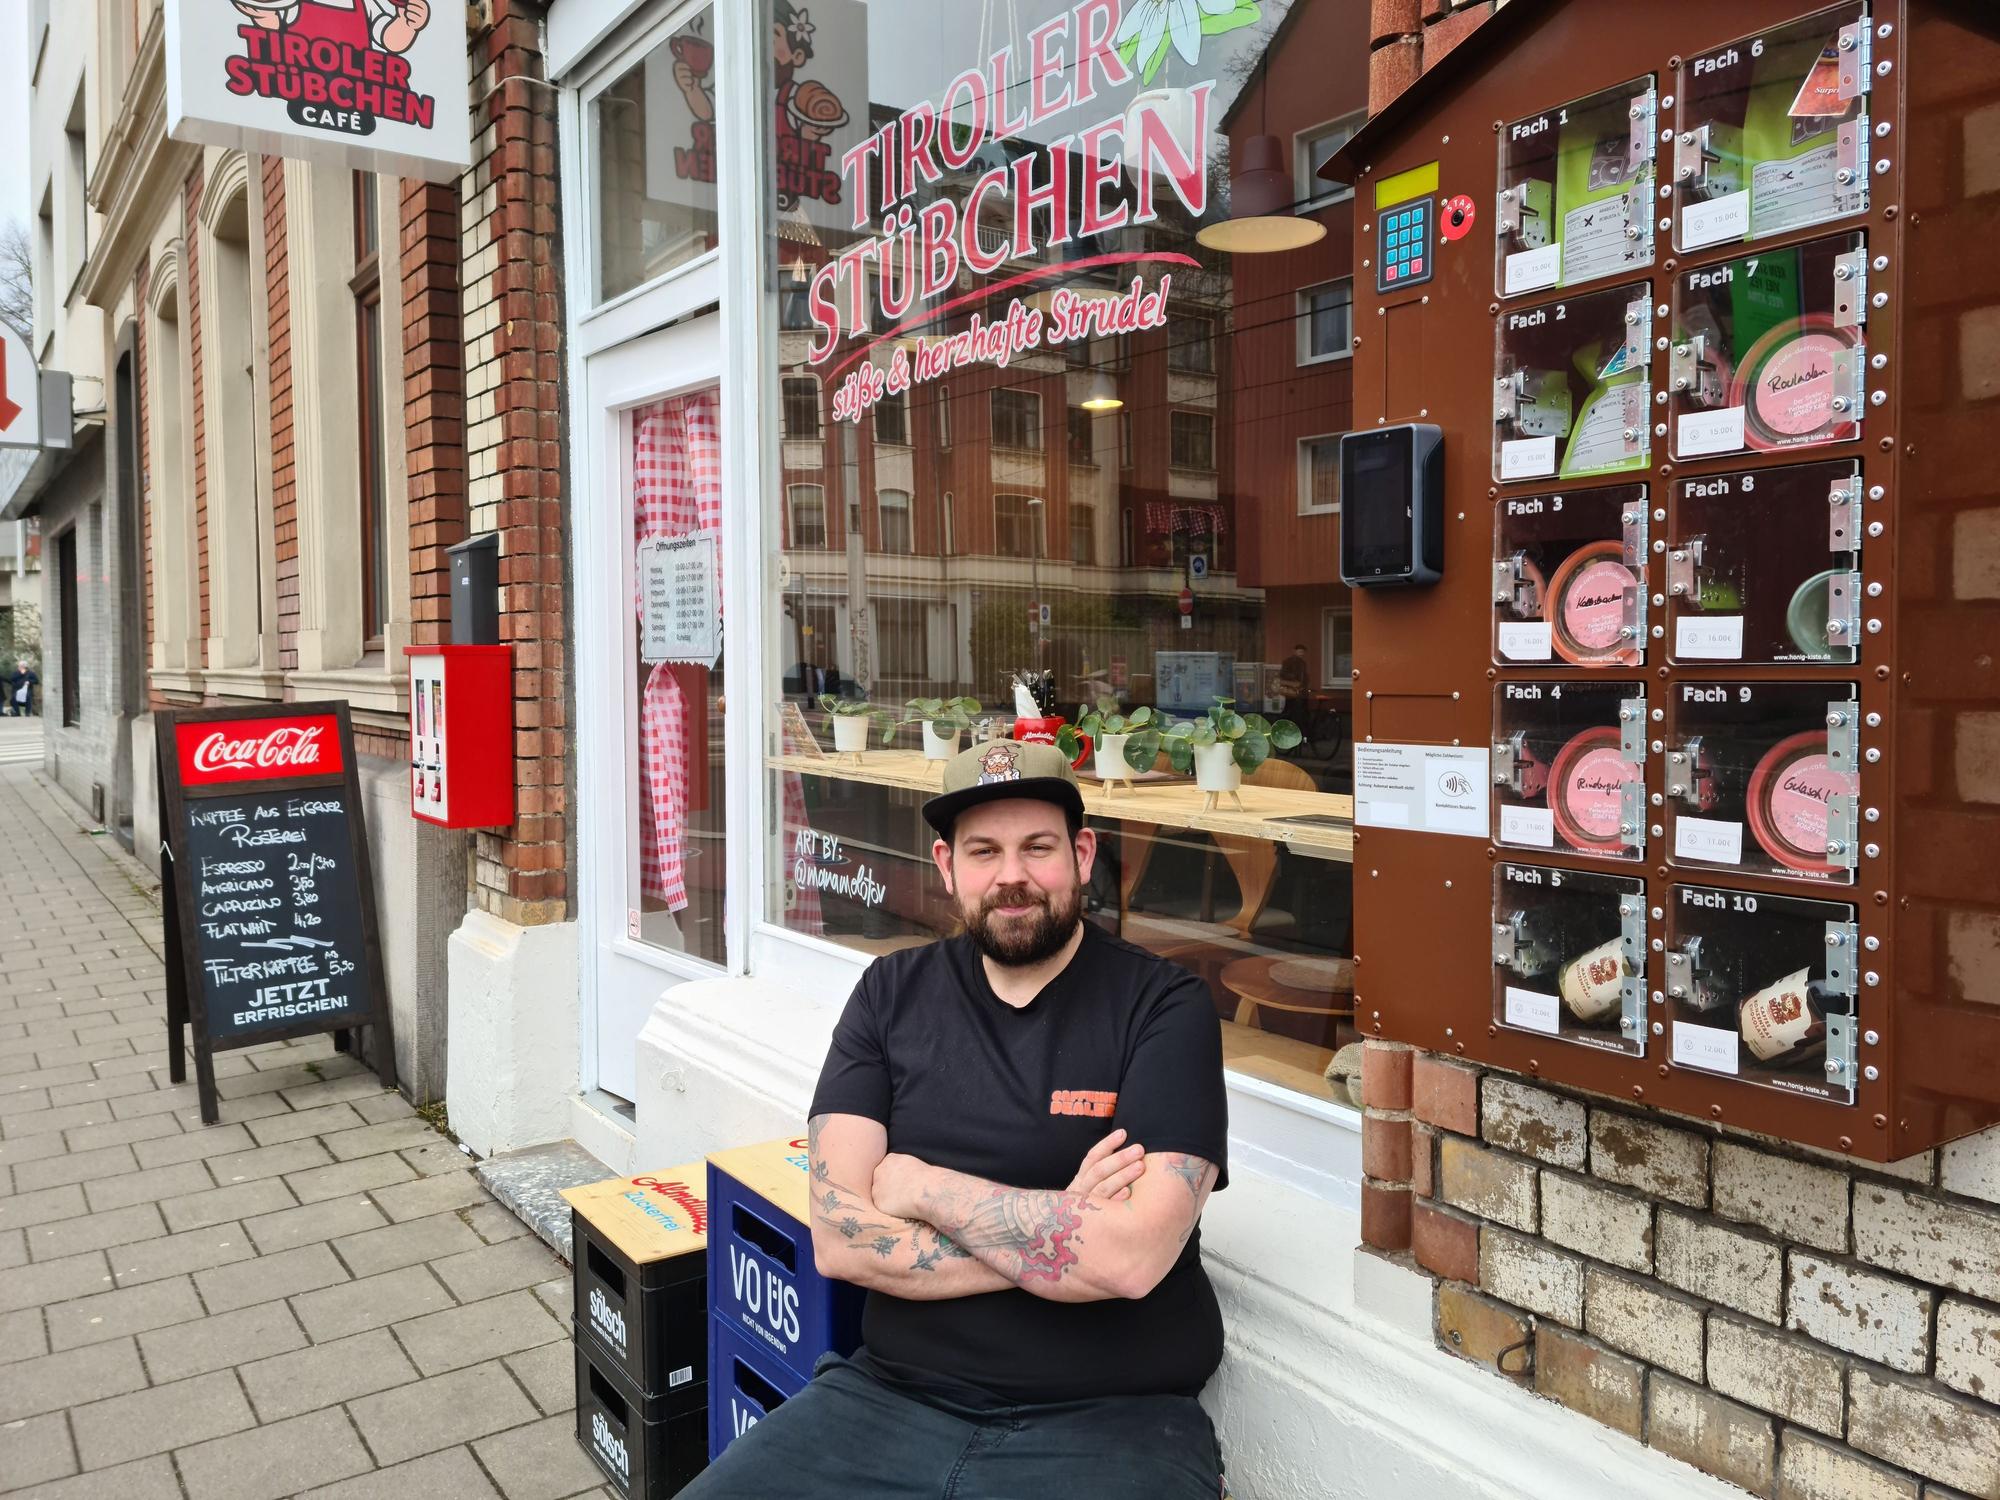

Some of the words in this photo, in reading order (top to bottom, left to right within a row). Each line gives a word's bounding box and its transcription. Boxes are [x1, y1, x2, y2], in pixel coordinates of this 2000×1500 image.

[239, 26, 410, 89] TIROLER
[1694, 50, 1738, 76] Fach
[1752, 39, 1763, 56] 6
[226, 57, 434, 128] STÜBCHEN
[302, 106, 361, 131] CAFÉ
[842, 0, 1133, 230] TIROLER
[1512, 116, 1548, 141] Fach
[1560, 110, 1568, 125] 1
[1446, 198, 1474, 217] START
[808, 79, 1216, 366] STÜBCHEN
[1690, 266, 1734, 290] Fach
[1747, 259, 1759, 277] 7
[1510, 310, 1546, 330] Fach
[1556, 305, 1566, 320] 2
[832, 360, 883, 424] süße
[886, 346, 911, 396] &
[914, 298, 1041, 383] herzhafte
[1047, 274, 1172, 344] Strudel
[1767, 363, 1828, 392] Rouladen
[1776, 432, 1834, 446] www.honig-kiste.de
[1685, 479, 1729, 498] Fach
[1741, 476, 1754, 492] 8
[1508, 499, 1543, 515] Fach
[1553, 496, 1563, 511] 3
[655, 538, 697, 552] Öffnungszeiten
[1773, 653, 1831, 661] www.honig-kiste.de
[1506, 685, 1542, 699] Fach
[1551, 685, 1562, 699] 4
[1683, 687, 1727, 702] Fach
[1739, 687, 1752, 703] 9
[193, 726, 324, 772] Coca-Cola
[795, 829, 819, 856] ART
[822, 834, 842, 861] BY:
[201, 856, 265, 878] ESPRESSO
[1506, 866, 1542, 884] Fach
[1551, 870, 1562, 886] 5
[1772, 867, 1829, 879] www.honig-kiste.de
[1682, 890, 1726, 909] Fach
[1733, 896, 1757, 912] 10
[294, 912, 322, 929] 4,20
[248, 978, 331, 1007] JETZT
[233, 995, 349, 1025] ERFRISCHEN!
[1772, 1078, 1829, 1097] www.honig-kiste.de
[623, 1190, 681, 1232] Zuckerfrei
[730, 1244, 761, 1314] VO
[767, 1270, 800, 1343] ÜS
[590, 1287, 627, 1349] sölsch
[592, 1412, 629, 1477] sölsch
